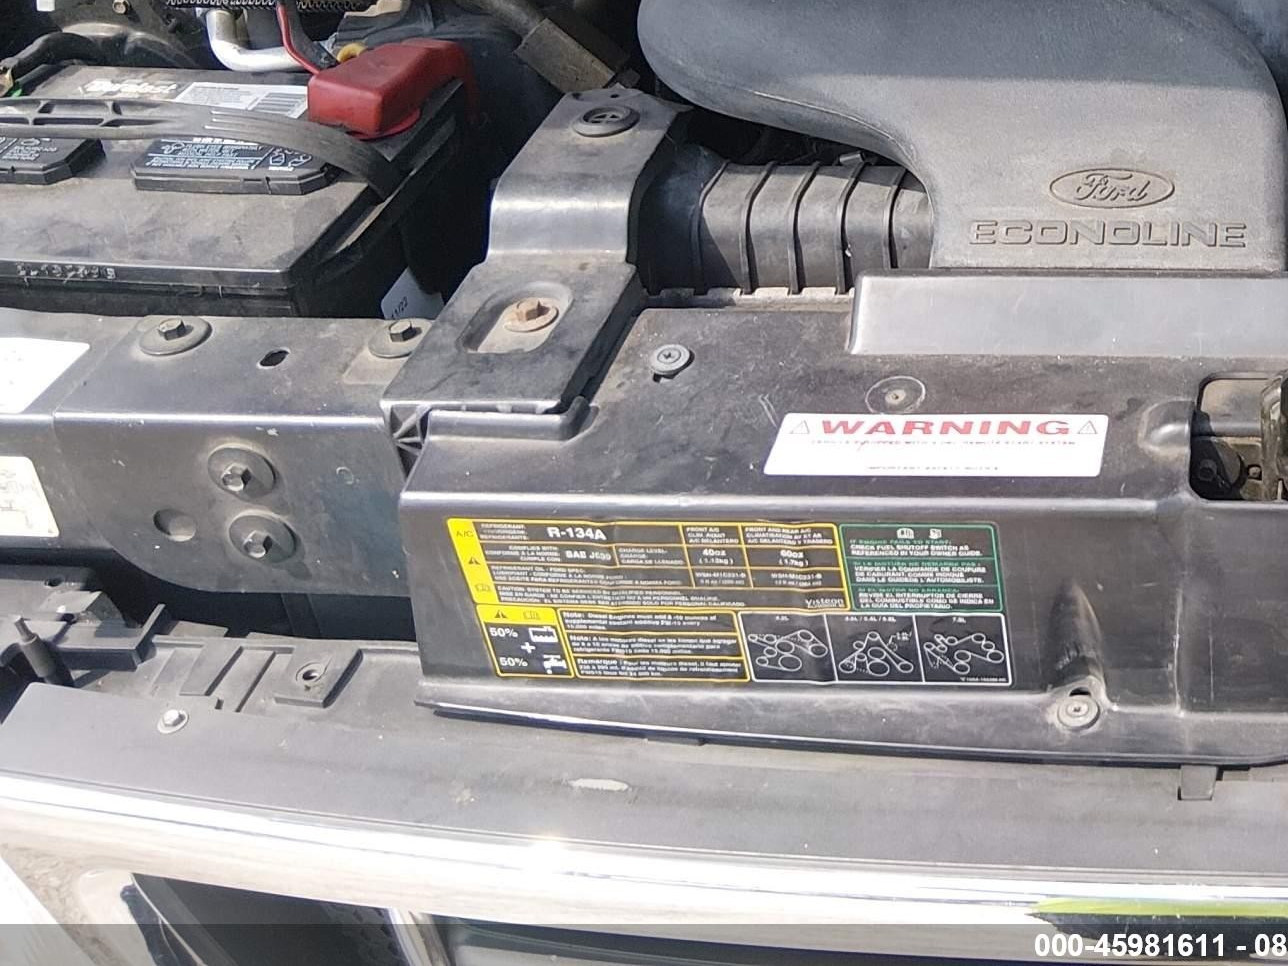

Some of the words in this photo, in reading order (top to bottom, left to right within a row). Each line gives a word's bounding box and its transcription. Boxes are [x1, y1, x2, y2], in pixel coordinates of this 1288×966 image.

[1075, 172, 1151, 202] Ford
[969, 220, 1248, 247] ECONOLINE
[821, 420, 1070, 436] WARNING
[546, 526, 607, 541] R-134A
[565, 550, 588, 560] SAE
[702, 548, 727, 557] 40oz
[780, 549, 805, 558] 60oz
[489, 626, 519, 639] 50%
[499, 656, 529, 669] 50%
